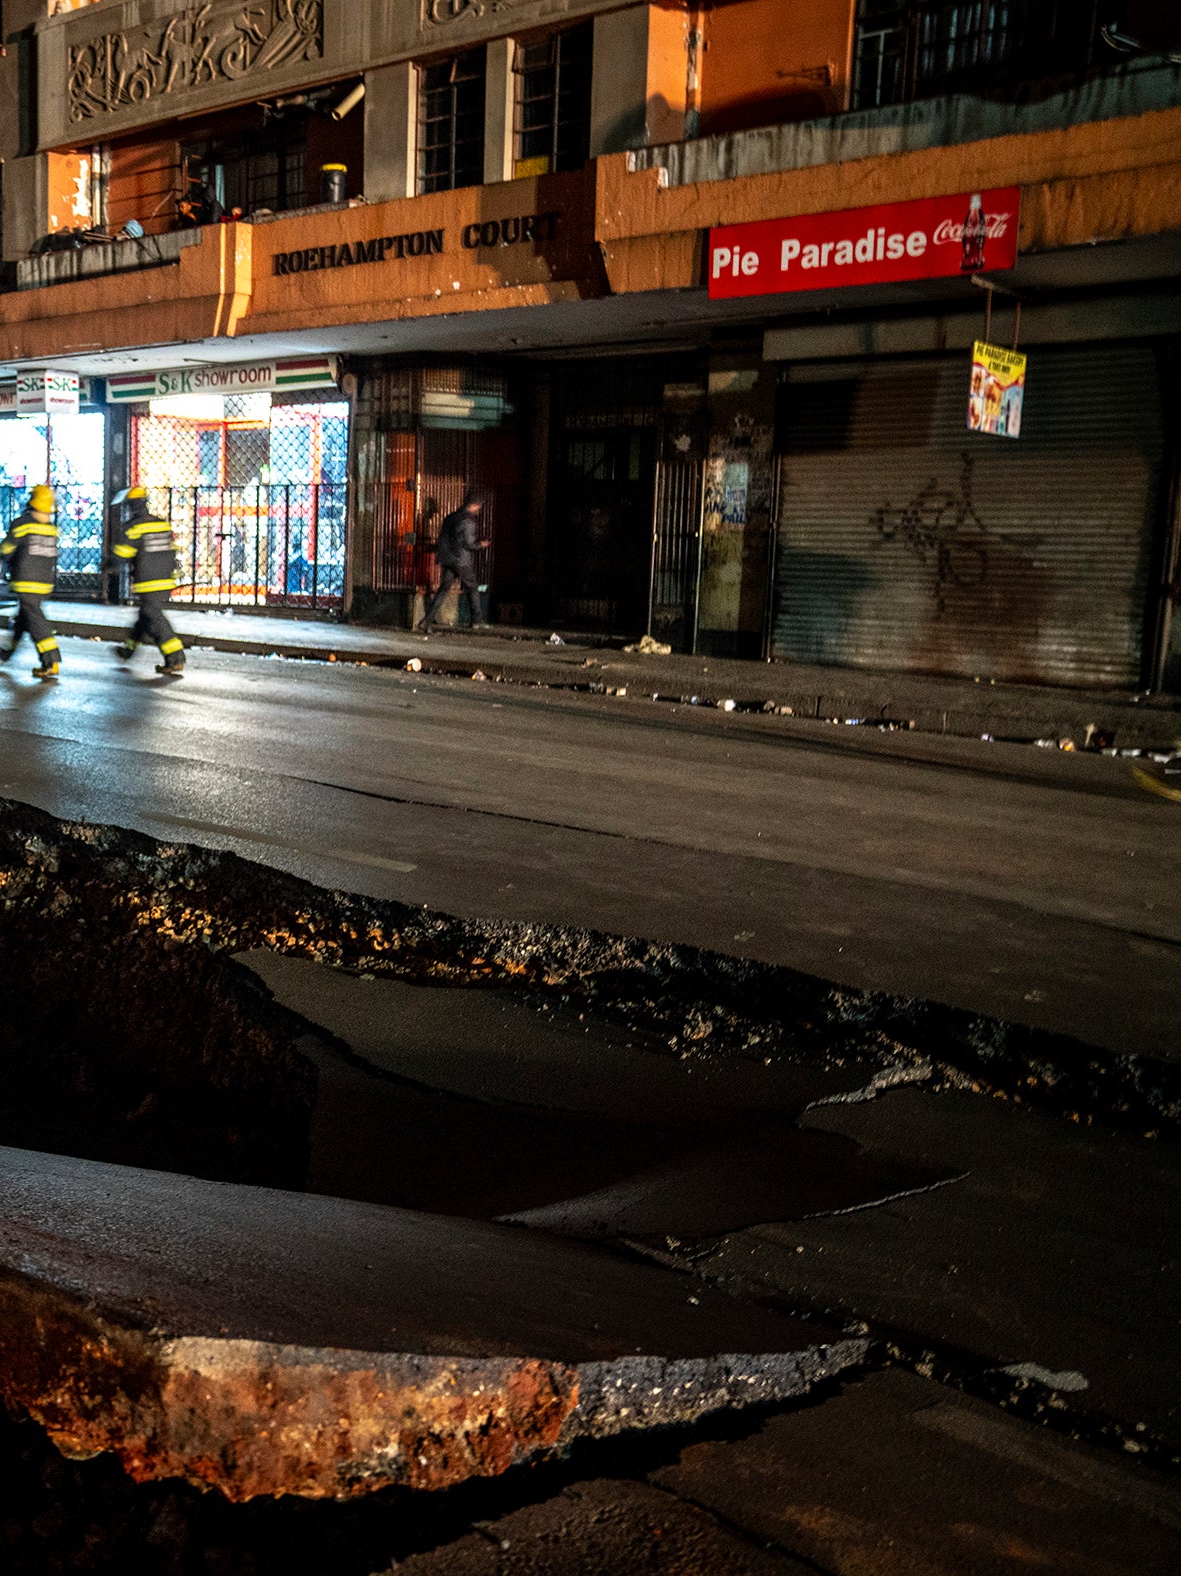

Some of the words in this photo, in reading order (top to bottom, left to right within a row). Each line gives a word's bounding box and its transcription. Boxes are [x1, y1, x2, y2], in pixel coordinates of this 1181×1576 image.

[272, 229, 446, 276] ROEHAMPTON
[462, 211, 561, 250] COURT
[932, 212, 1013, 246] Cocaola
[712, 246, 760, 279] Pie
[781, 227, 928, 272] Paradise
[194, 366, 272, 388] showroom
